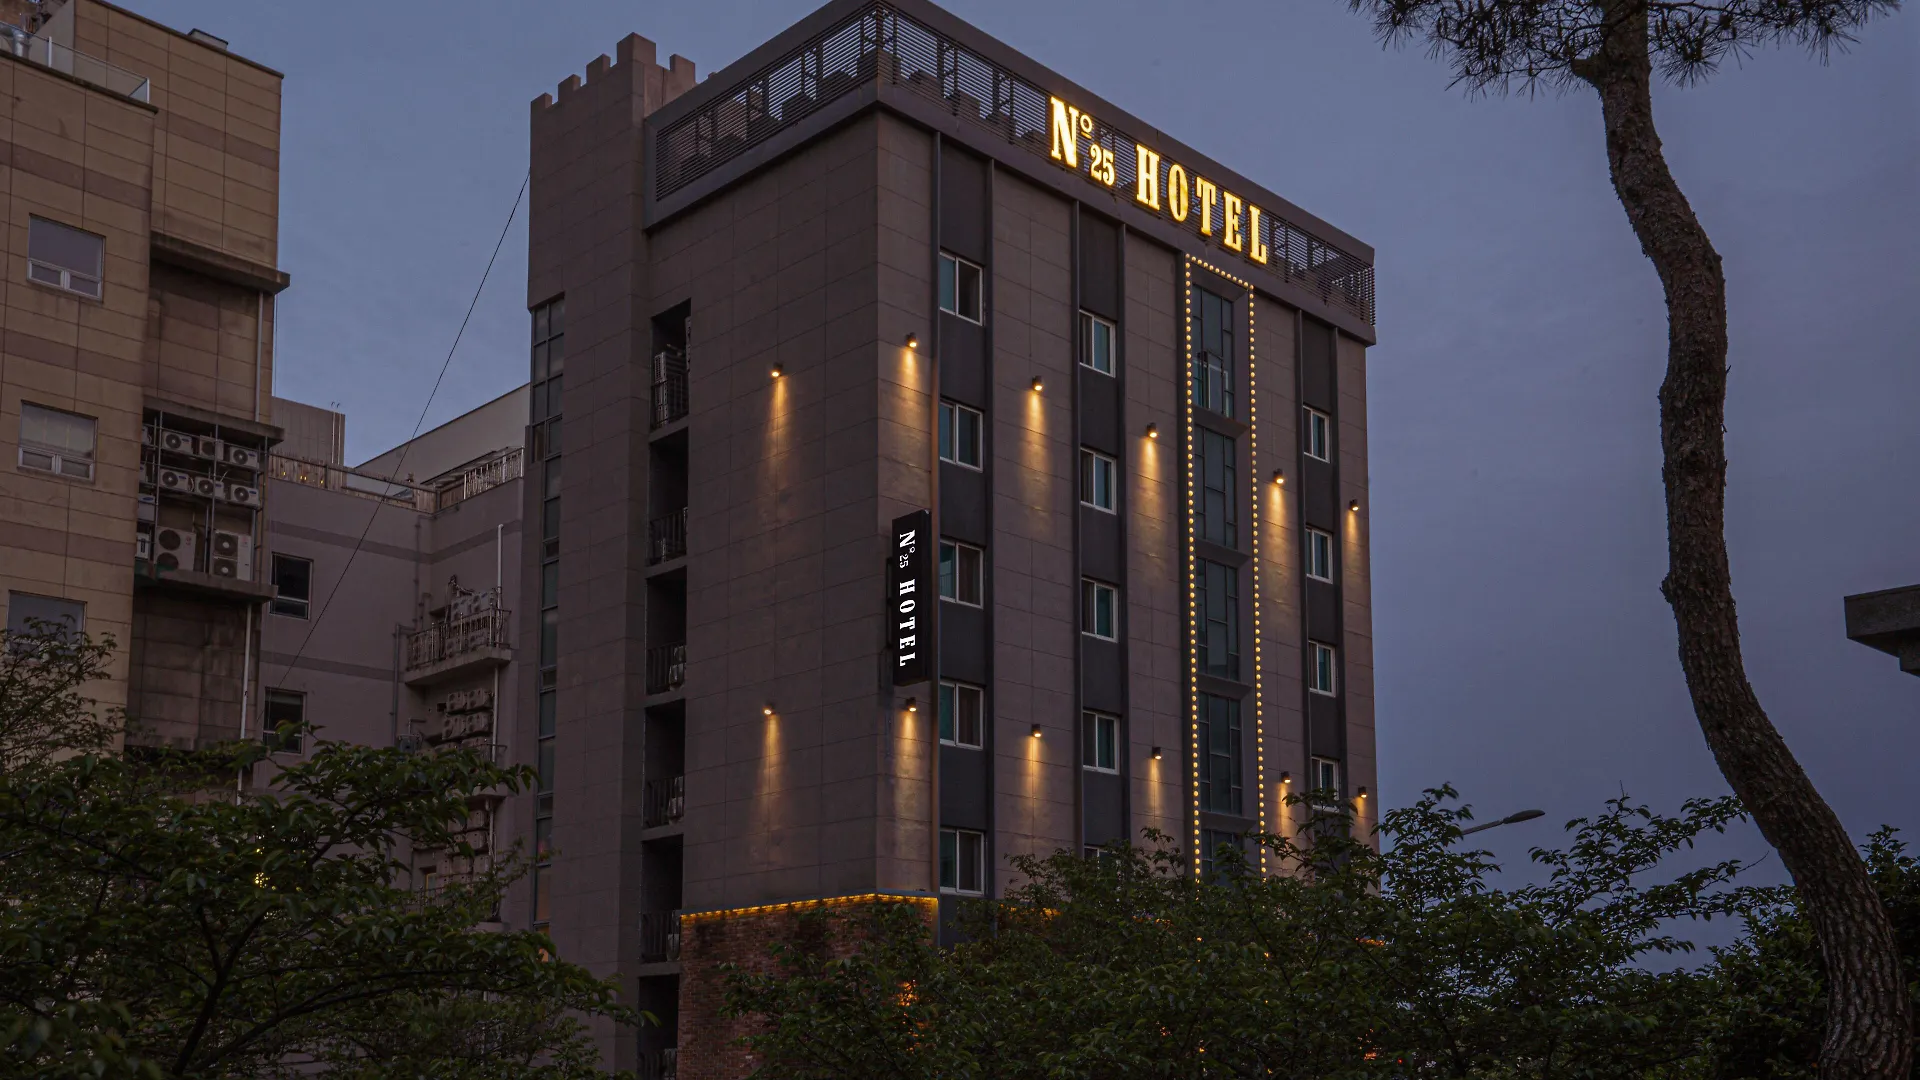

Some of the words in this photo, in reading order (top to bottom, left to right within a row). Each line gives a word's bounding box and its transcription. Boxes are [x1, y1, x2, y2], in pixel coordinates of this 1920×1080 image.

[1090, 144, 1115, 186] 25
[1136, 144, 1267, 265] HOTEL
[899, 554, 909, 568] 25
[899, 578, 916, 667] HOTEL
